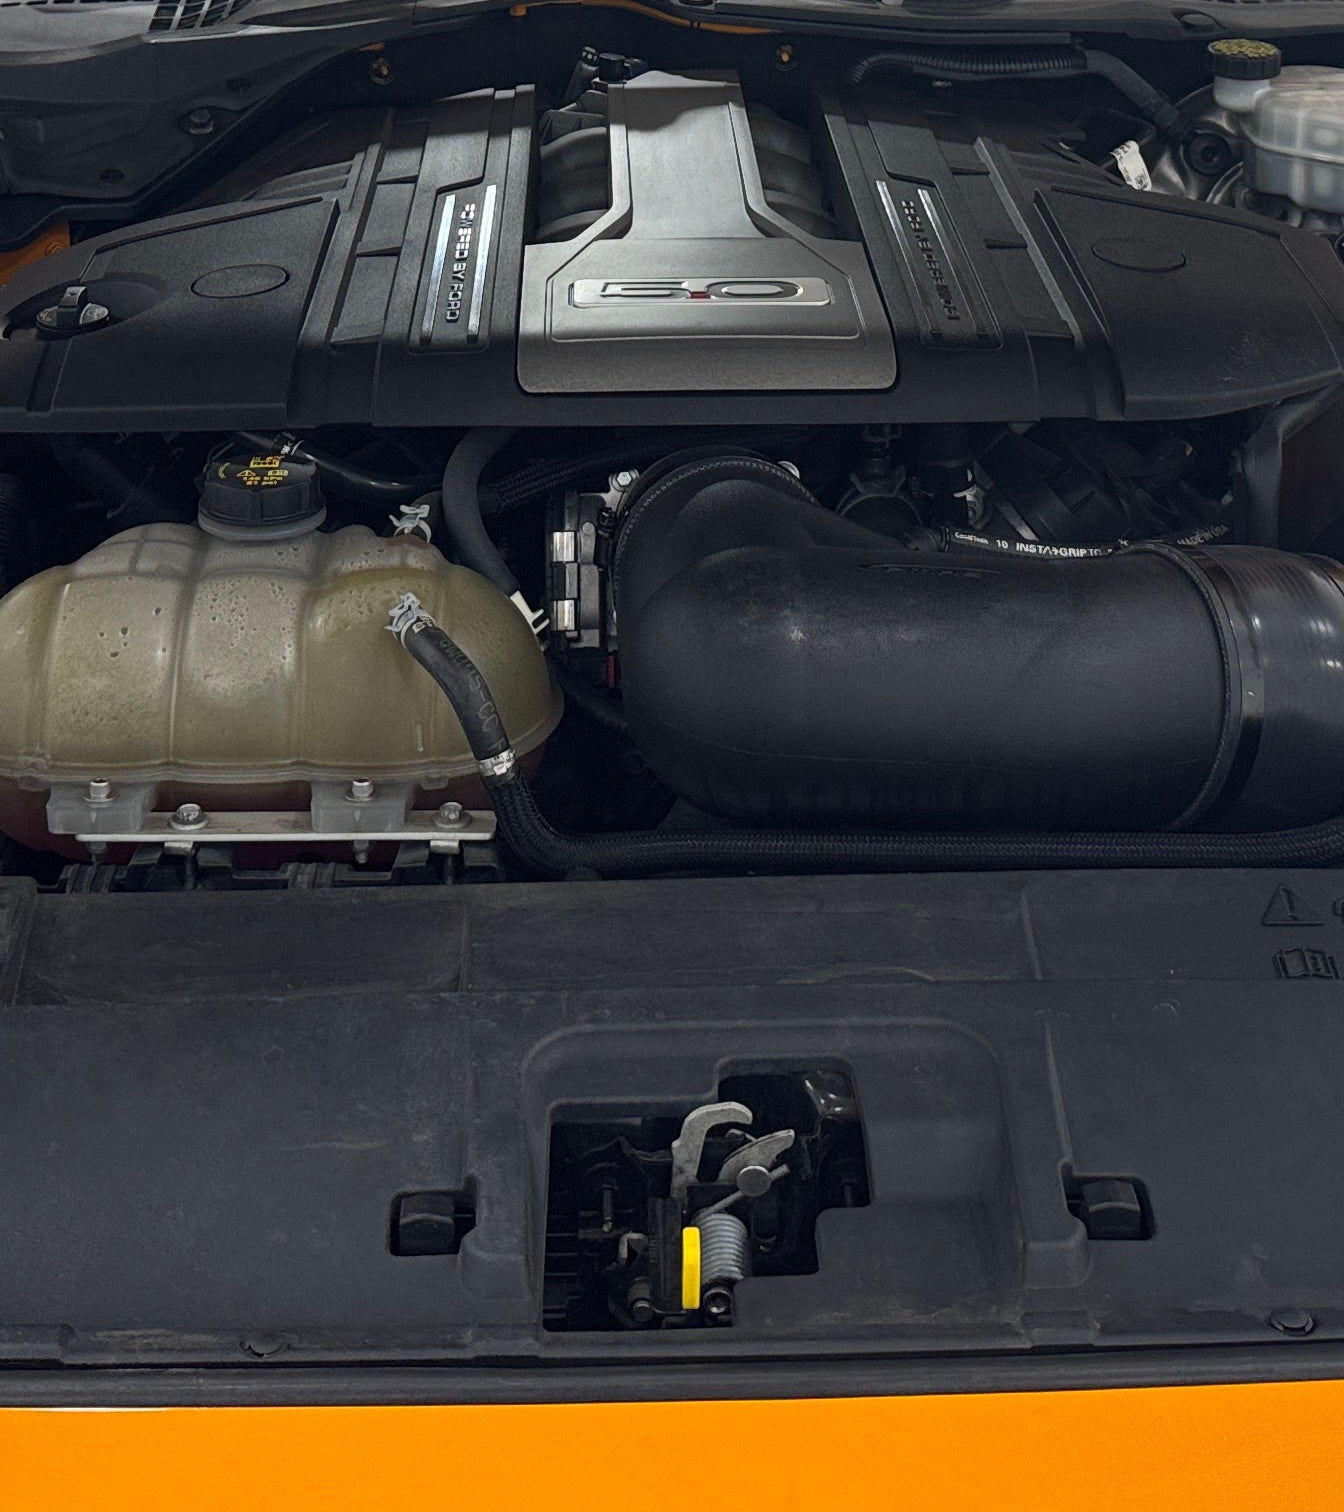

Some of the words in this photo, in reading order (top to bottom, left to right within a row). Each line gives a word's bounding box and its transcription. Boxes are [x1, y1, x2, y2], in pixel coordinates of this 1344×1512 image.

[454, 202, 476, 260] POWERED
[451, 261, 467, 283] BY
[599, 280, 805, 301] 5.0
[445, 282, 464, 323] FORD
[995, 539, 1009, 549] 10
